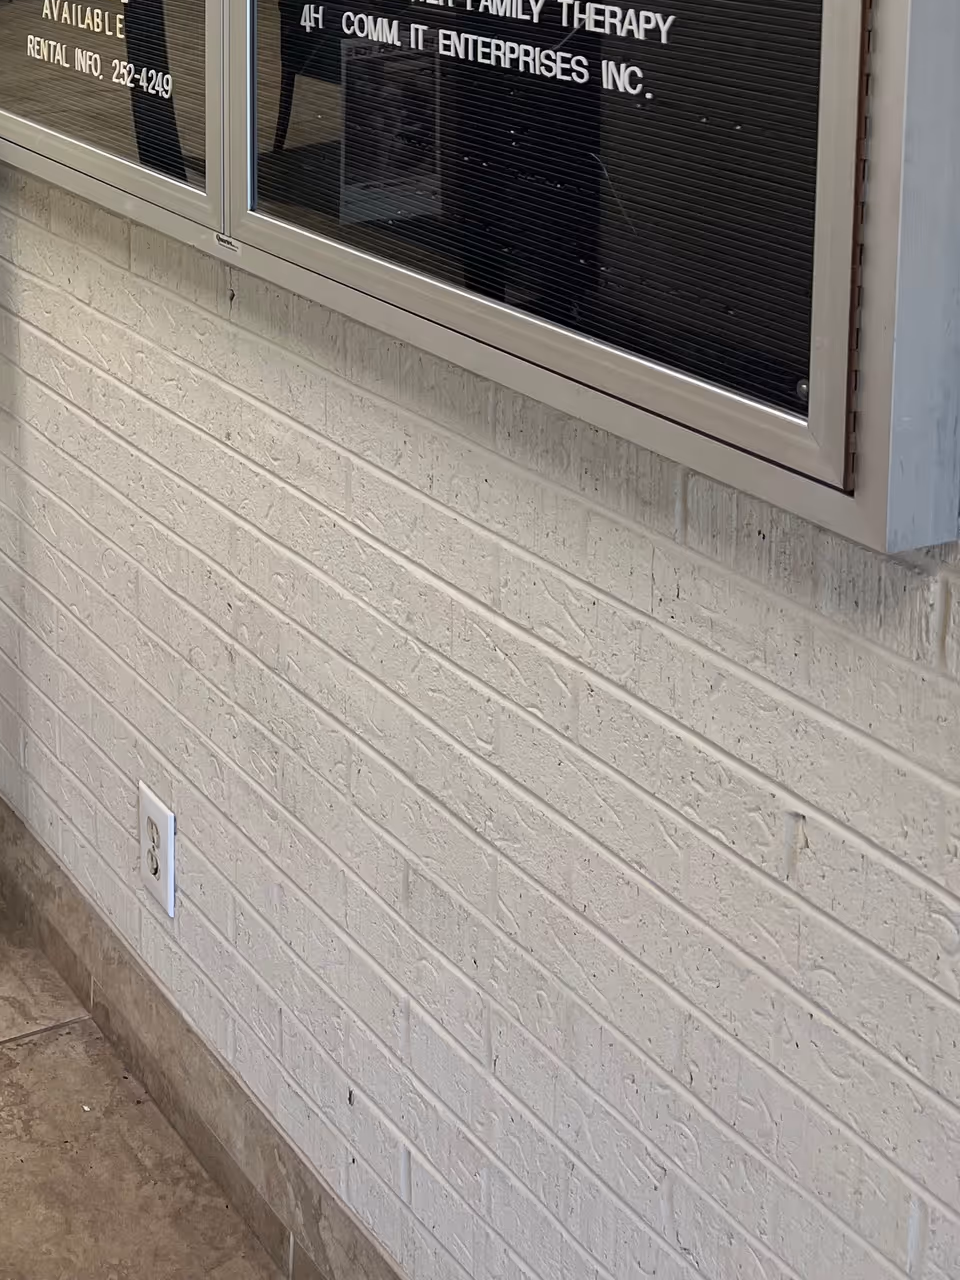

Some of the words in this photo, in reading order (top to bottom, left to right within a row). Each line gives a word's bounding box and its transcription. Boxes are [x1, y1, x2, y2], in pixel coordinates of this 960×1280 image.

[27, 35, 70, 68] RENTAL
[112, 59, 173, 99] 252-4249
[300, 4, 324, 33] 4H
[410, 23, 429, 50] IT
[438, 30, 589, 85] ENTERPRISES
[601, 59, 654, 100] INC.
